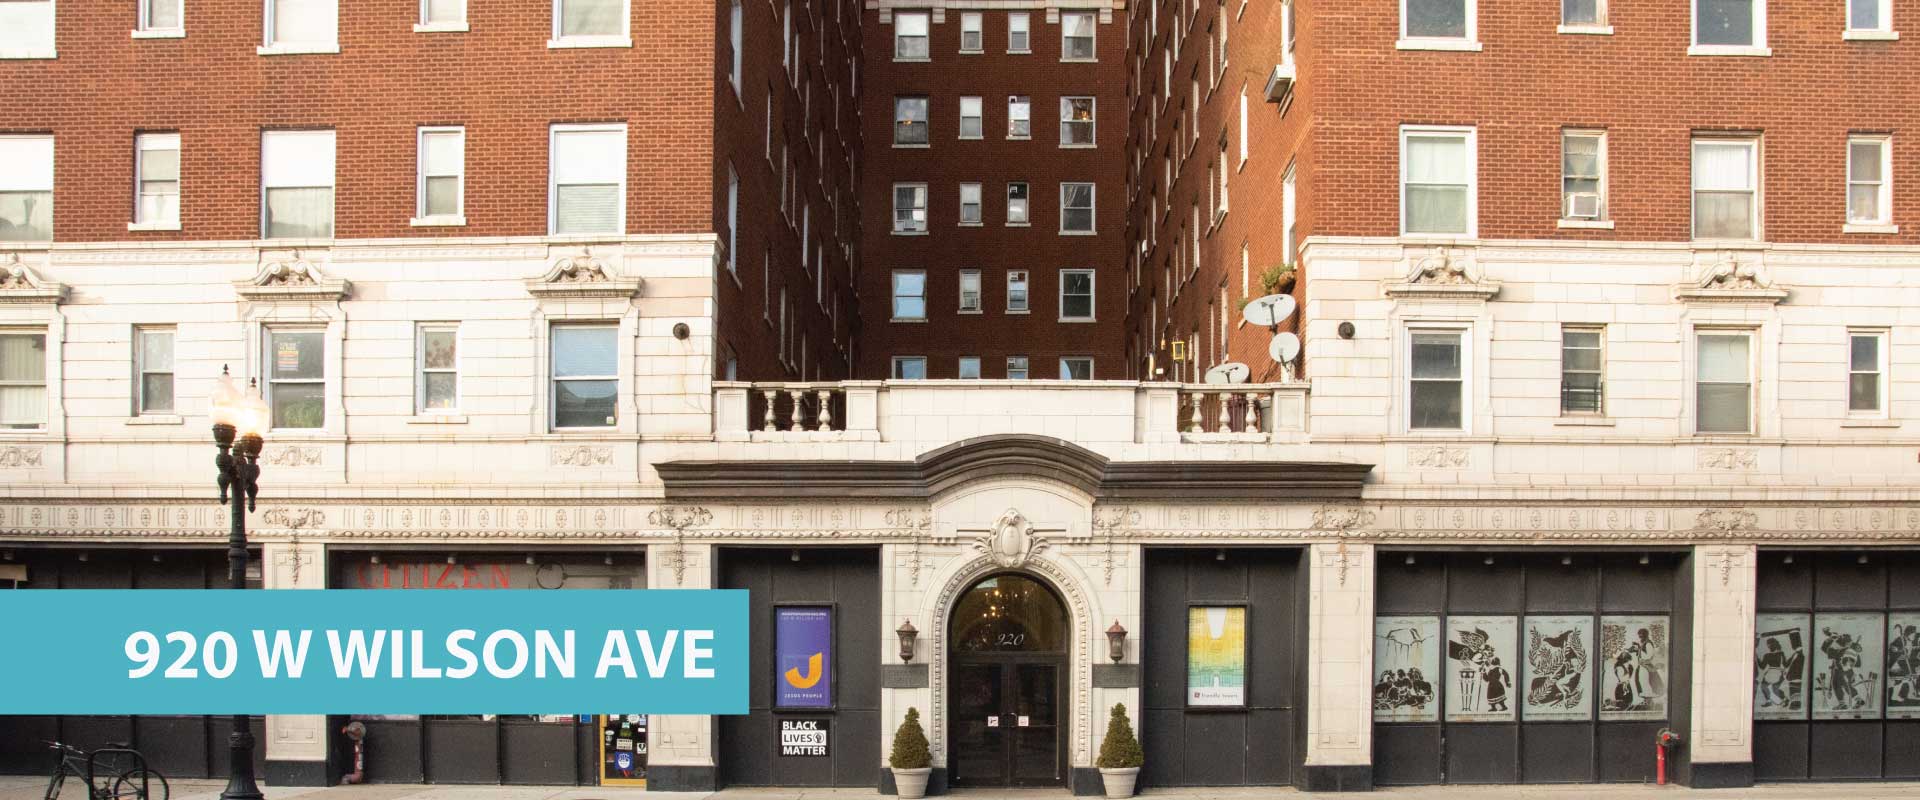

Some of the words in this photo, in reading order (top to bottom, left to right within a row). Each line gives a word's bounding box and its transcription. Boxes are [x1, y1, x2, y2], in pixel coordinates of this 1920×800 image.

[357, 562, 511, 589] CITIZEN
[996, 633, 1024, 646] 920
[782, 721, 818, 730] BLACK
[783, 734, 813, 743] LIVES
[782, 746, 826, 756] MATTER
